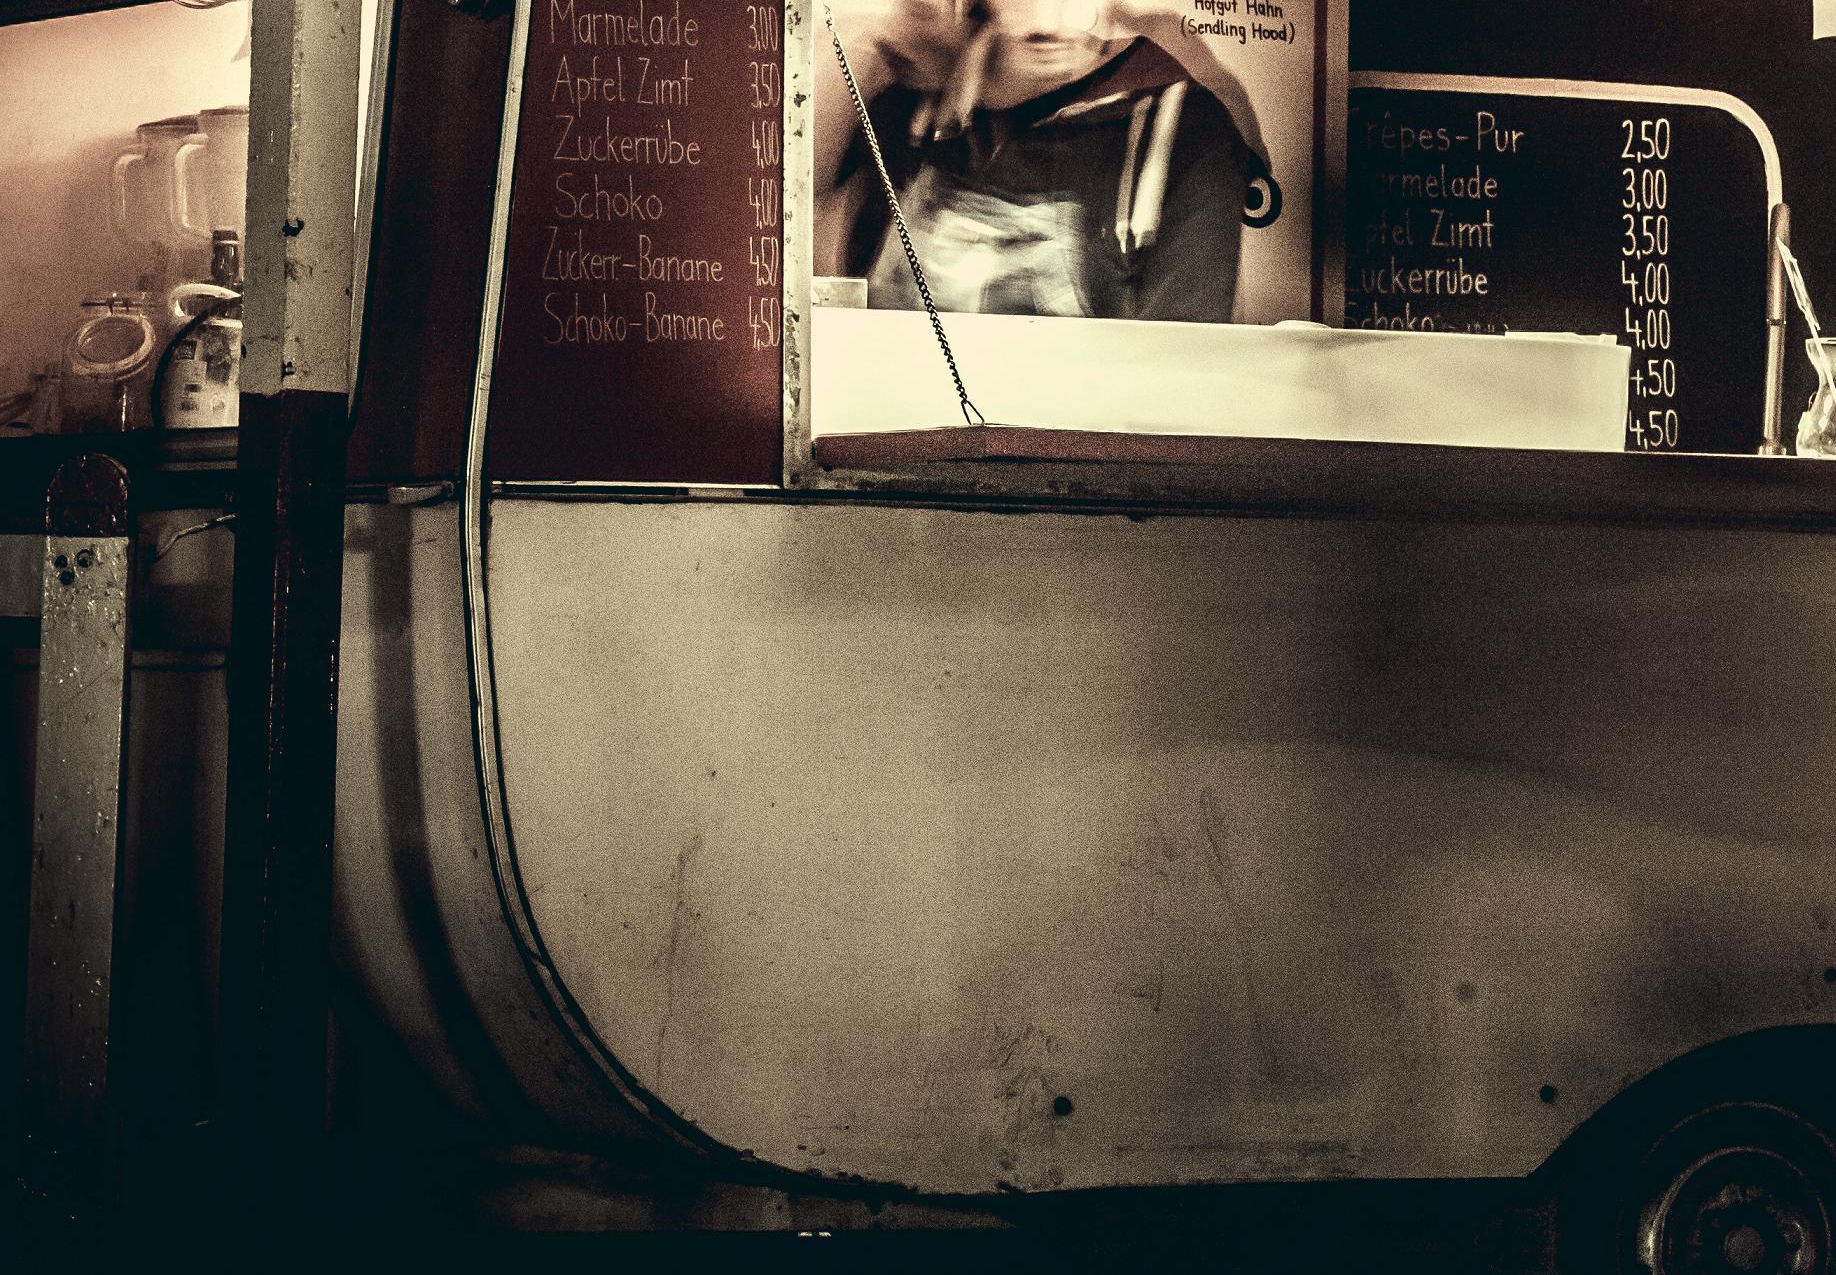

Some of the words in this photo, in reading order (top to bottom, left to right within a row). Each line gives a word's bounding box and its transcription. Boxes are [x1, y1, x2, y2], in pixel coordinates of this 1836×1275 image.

[746, 5, 778, 52] 3,00
[1180, 15, 1247, 45] (Sendling
[1252, 21, 1296, 44] Hood)
[551, 55, 625, 115] Apfel
[637, 57, 694, 108] Zimt
[749, 62, 780, 109] 3,50
[553, 115, 701, 166] Zuckerrübe
[751, 120, 780, 168] 4,00
[1621, 118, 1671, 163] 2,50
[555, 172, 663, 221] Schoko
[748, 177, 778, 229] 4,00
[1622, 168, 1669, 211] 3,00
[1430, 208, 1495, 249] Zimt
[1622, 214, 1670, 259] 3,50
[749, 235, 779, 287] 4,50
[1621, 262, 1671, 306] 4,00
[543, 292, 725, 345] Schoko-Banane
[748, 296, 780, 350] 4,50
[1624, 307, 1671, 350] 4,00
[1628, 409, 1679, 450] 4,50
